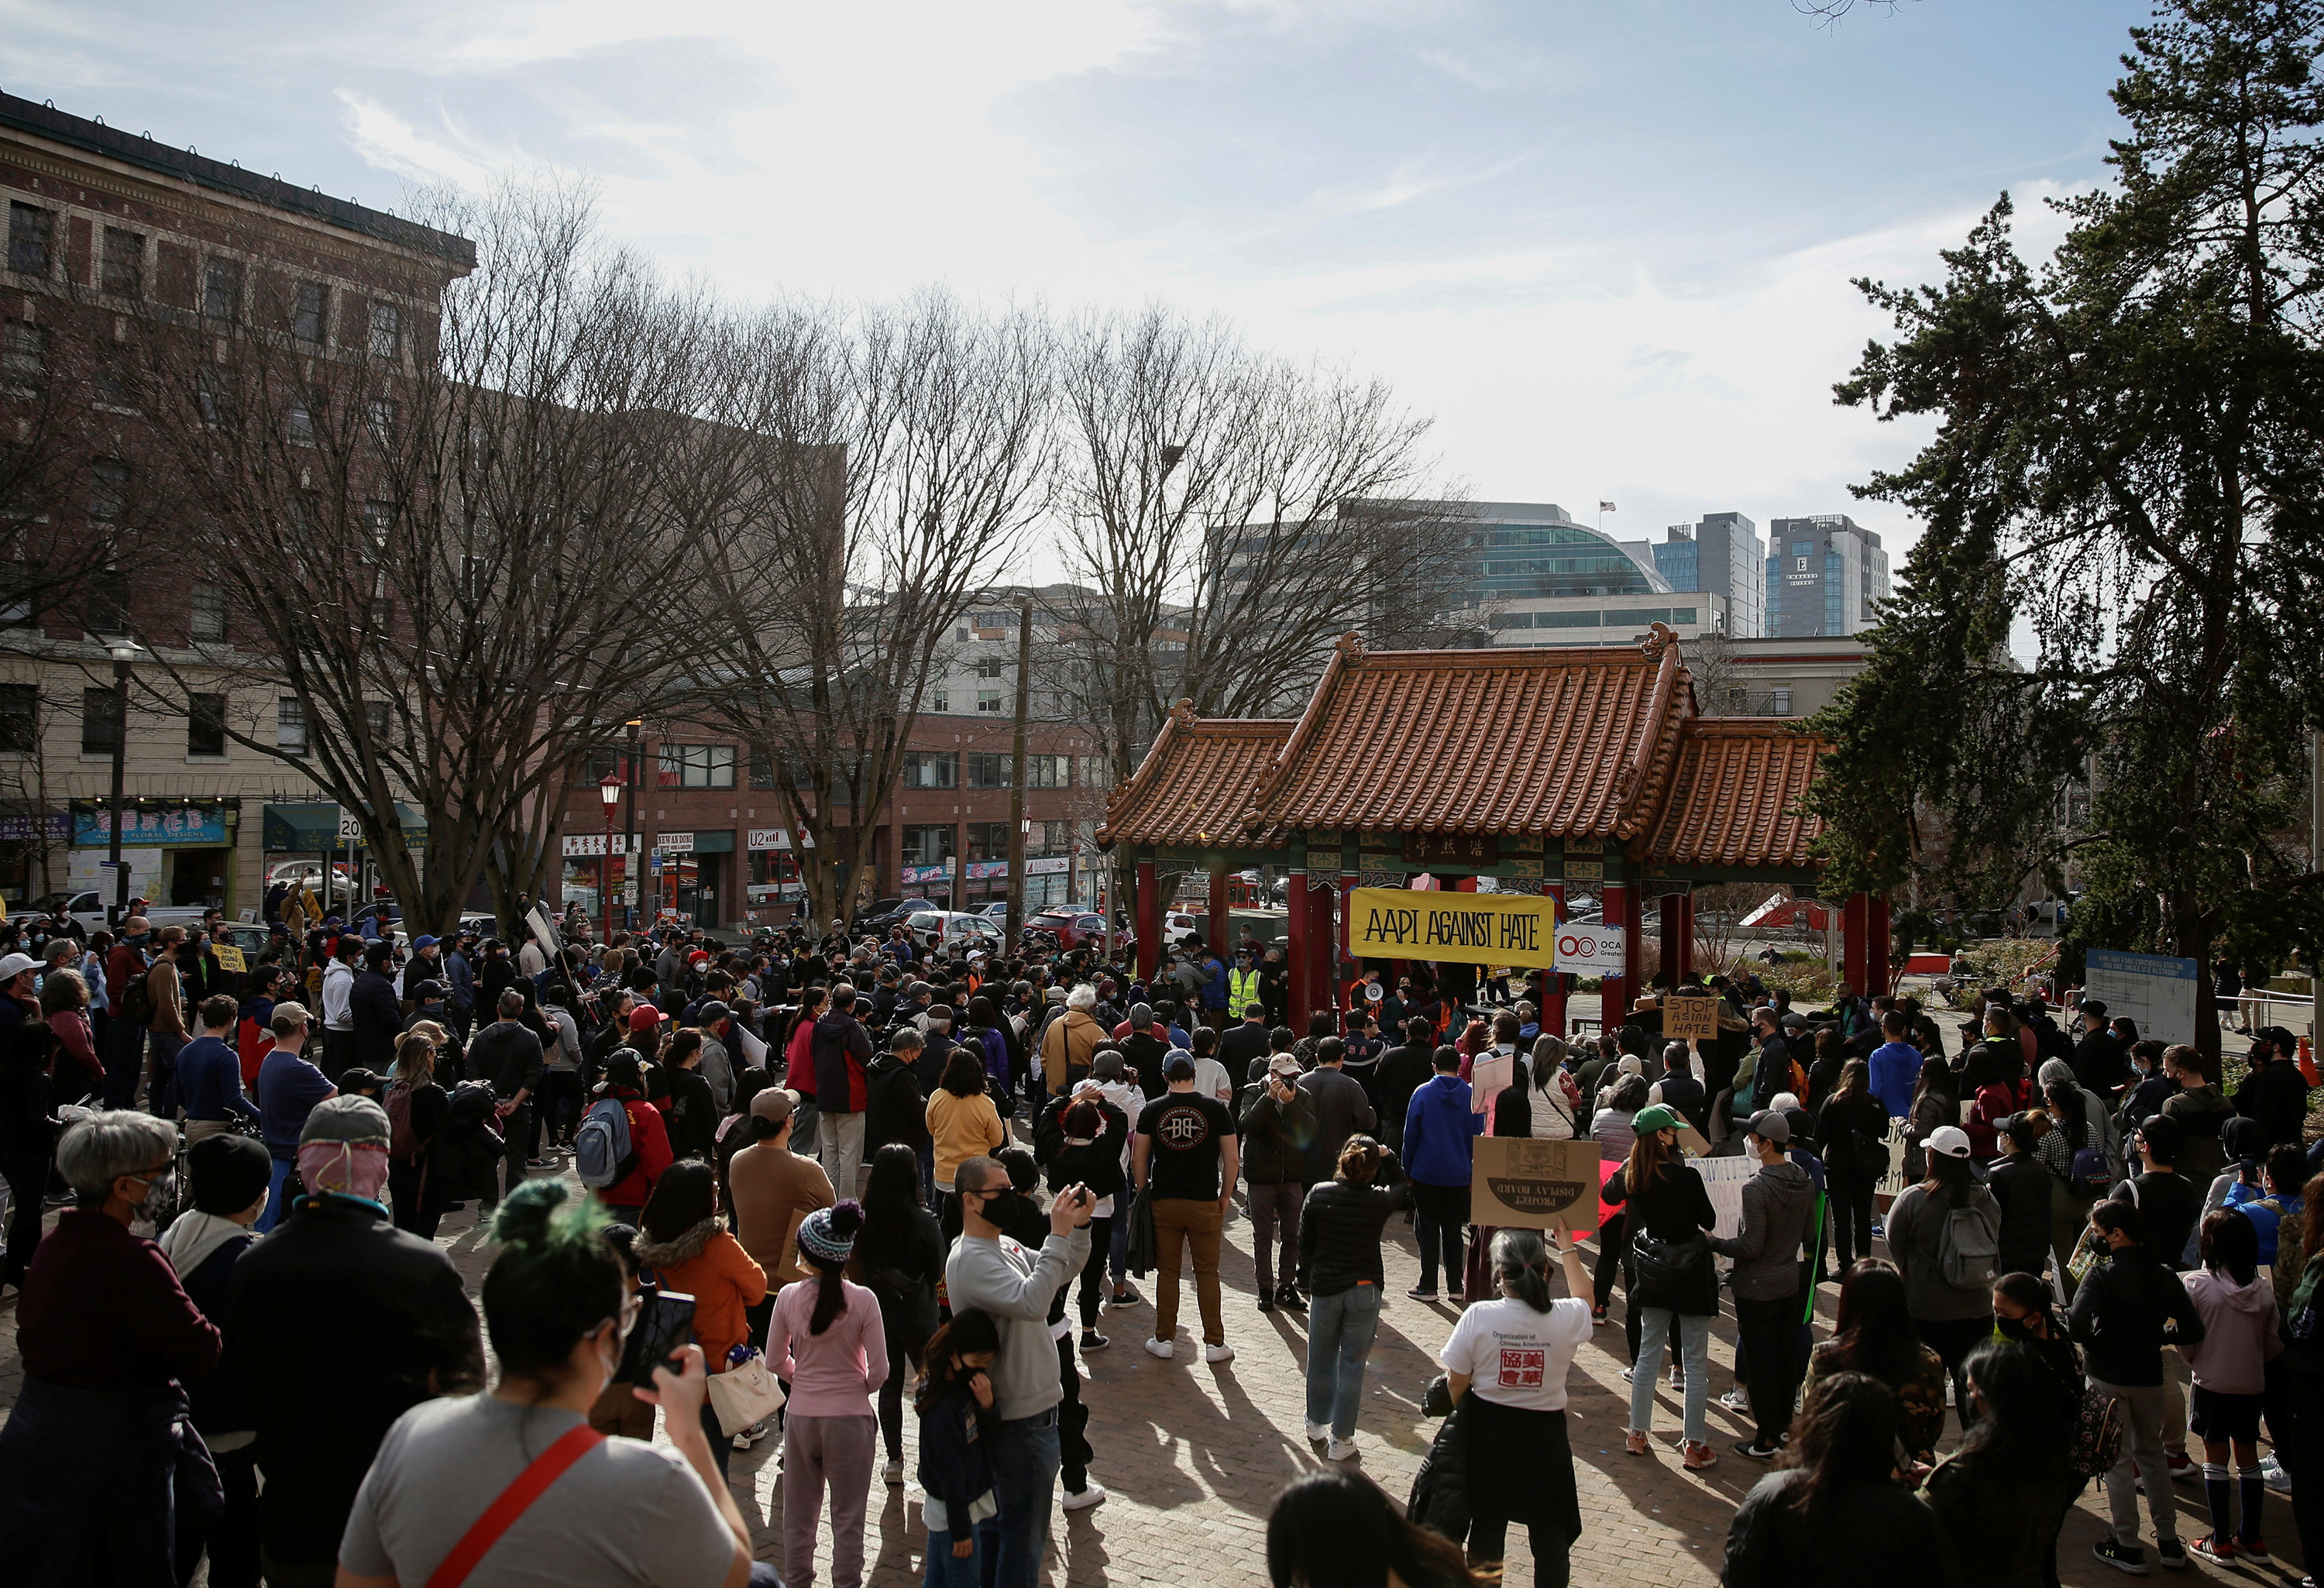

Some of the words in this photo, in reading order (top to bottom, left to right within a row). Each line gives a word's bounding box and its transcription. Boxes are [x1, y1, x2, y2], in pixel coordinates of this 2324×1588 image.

[341, 820, 359, 837] 20
[658, 835, 672, 844] NEW
[671, 835, 679, 844] AN
[679, 834, 693, 844] DONG
[750, 832, 765, 847] U2
[1363, 909, 1420, 945] AAPI
[1425, 910, 1495, 949] AGAINST
[1499, 913, 1540, 951] HATE
[220, 946, 234, 954] STOP
[1600, 940, 1622, 950] OCA
[1668, 999, 1715, 1013] STOP
[1672, 1012, 1712, 1023] ASIAN
[1673, 1023, 1710, 1034] HATE
[1189, 1109, 1205, 1129] BREWERY
[1497, 1184, 1531, 1194] BOARD
[1536, 1185, 1575, 1197] DISPLAY
[1514, 1195, 1556, 1207] PROJECT
[1492, 1331, 1528, 1341] Organization
